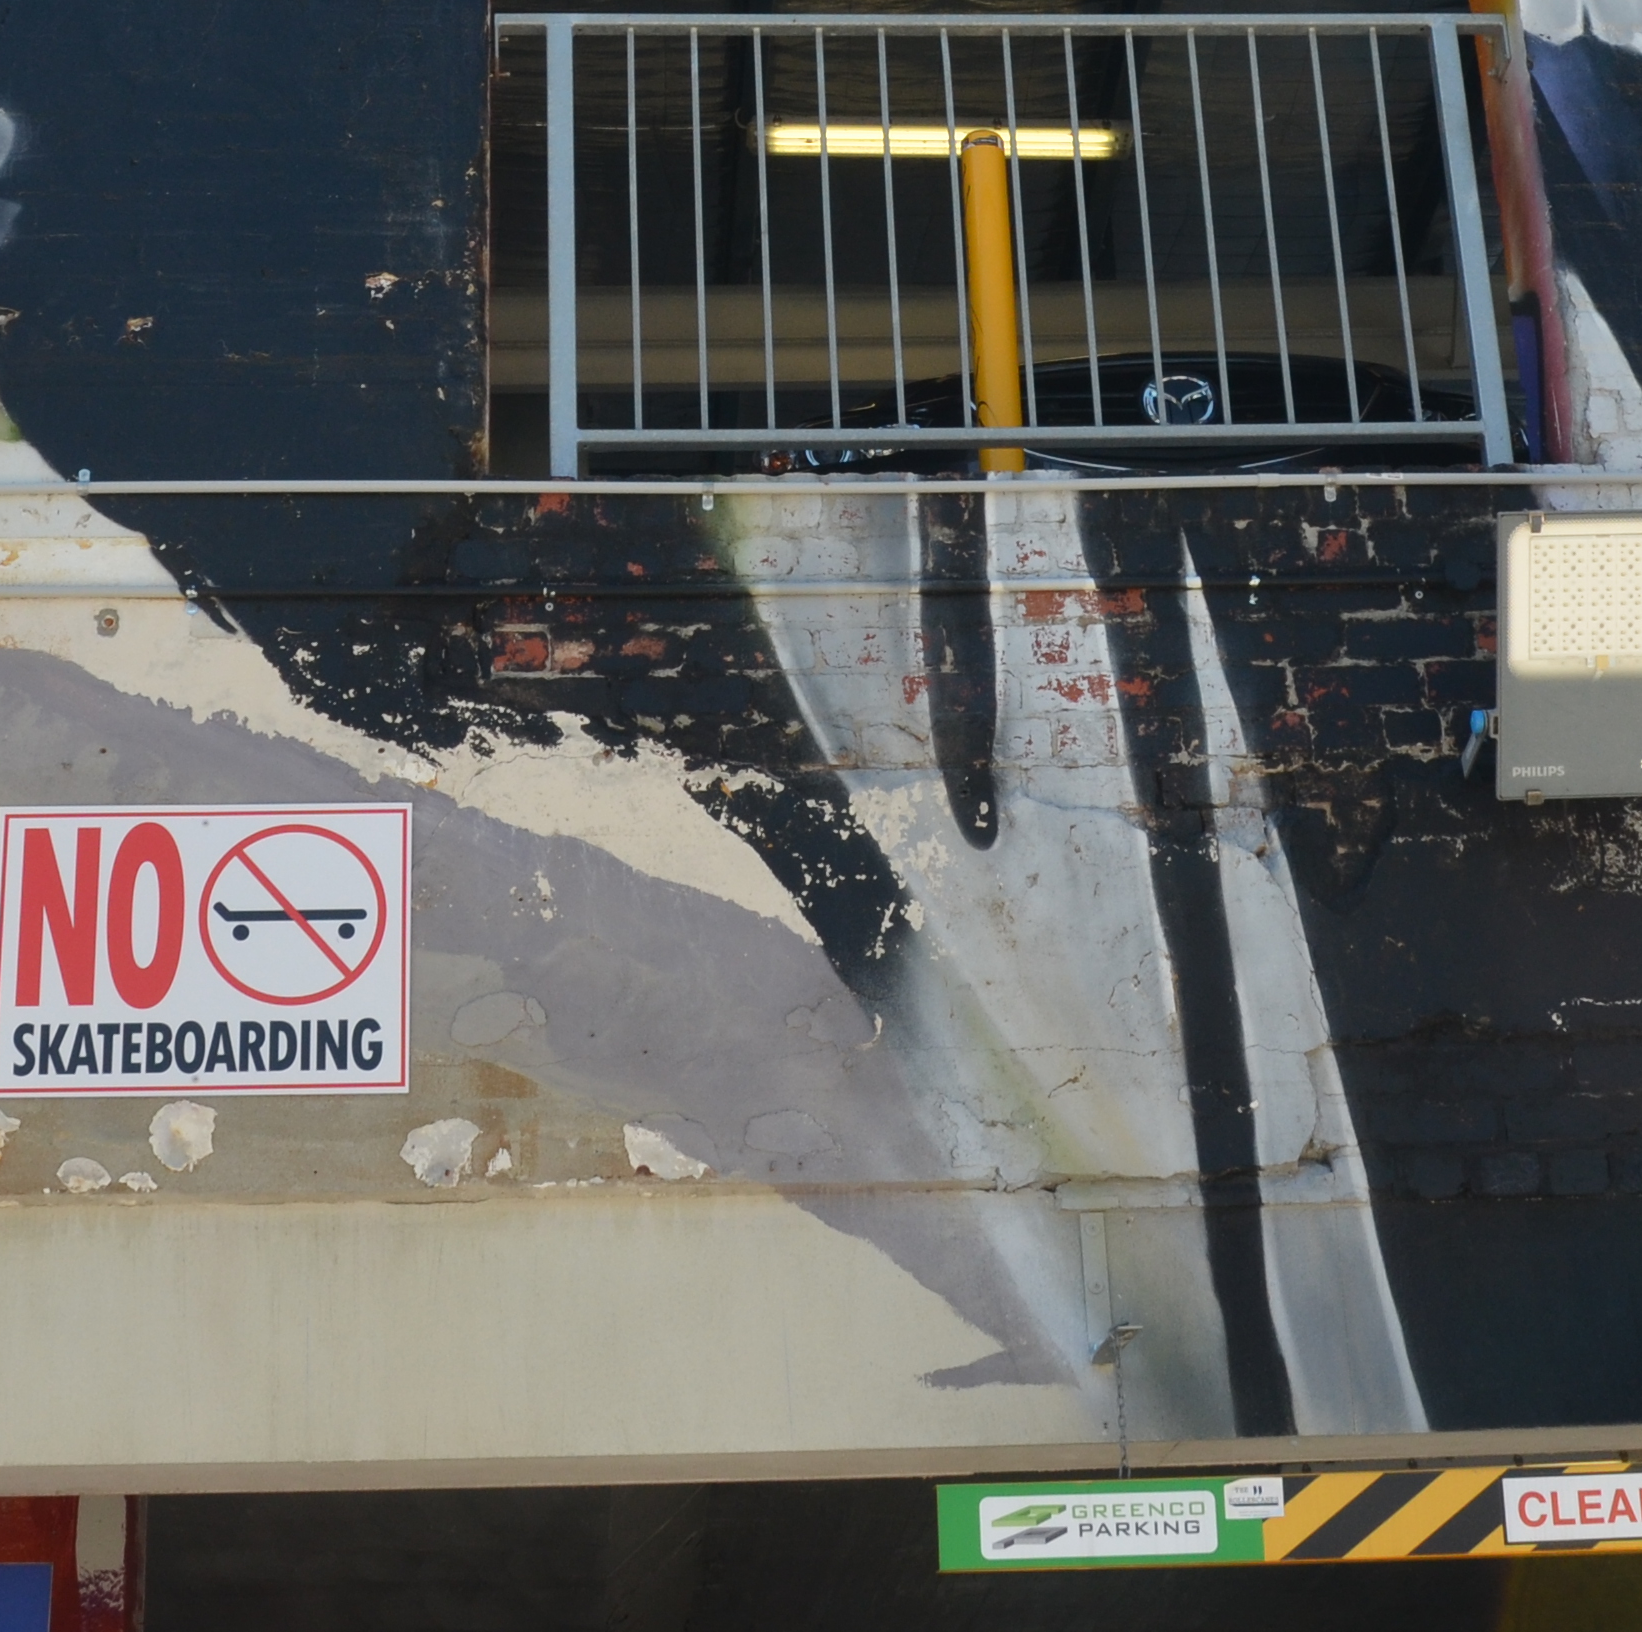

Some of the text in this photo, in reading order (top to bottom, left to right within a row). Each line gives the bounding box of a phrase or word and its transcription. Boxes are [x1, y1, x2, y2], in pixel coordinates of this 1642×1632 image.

[1512, 765, 1565, 777] PHILIPS
[15, 822, 185, 1009] NO
[12, 1018, 383, 1077] SKATEBOARDING
[1071, 1500, 1206, 1520] GREENCO
[1078, 1519, 1201, 1538] PARKING
